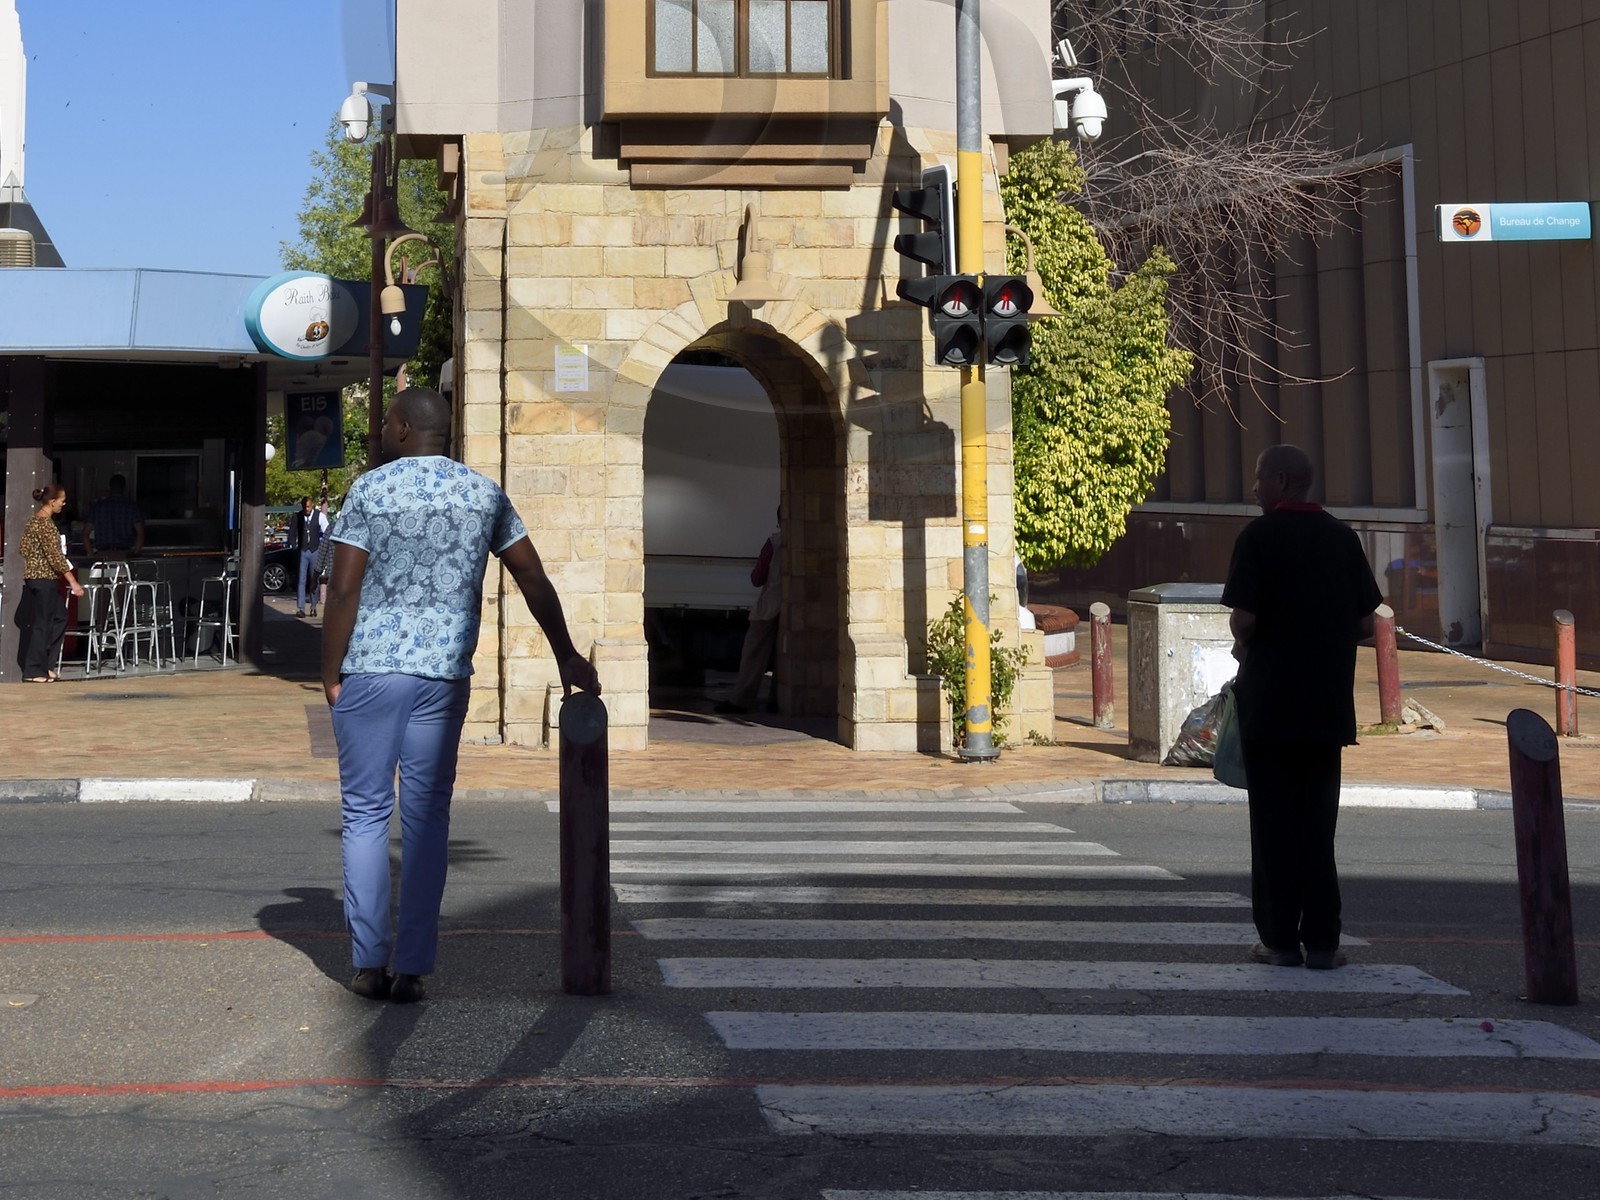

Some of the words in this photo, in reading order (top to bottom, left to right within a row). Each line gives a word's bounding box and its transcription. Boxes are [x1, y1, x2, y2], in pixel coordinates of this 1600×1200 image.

[1499, 216, 1531, 226] Bureau
[1533, 216, 1544, 225] de
[1546, 216, 1581, 226] Change
[300, 396, 328, 412] EIS
